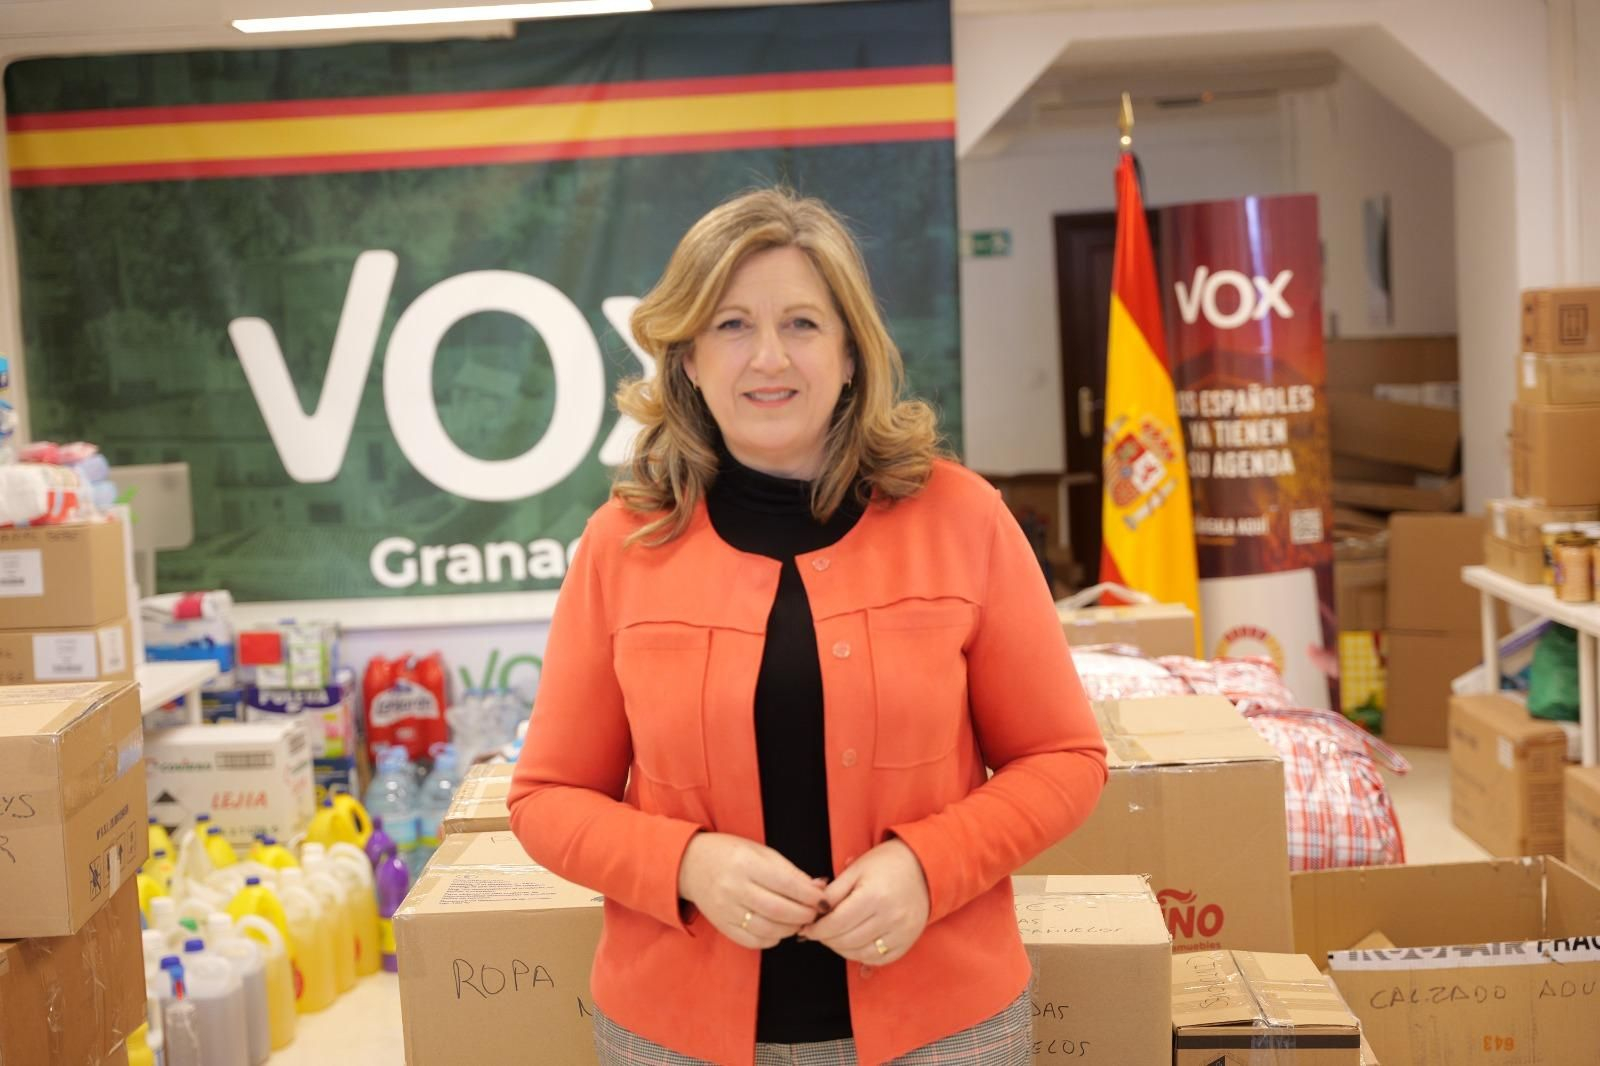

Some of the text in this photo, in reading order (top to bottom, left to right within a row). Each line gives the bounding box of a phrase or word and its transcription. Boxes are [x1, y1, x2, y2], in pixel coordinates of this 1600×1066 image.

[1175, 265, 1294, 329] VOX
[1200, 383, 1314, 418] ESPAÑOLES
[1188, 417, 1288, 448] YA TIENEN
[1212, 448, 1296, 478] AGENDA
[369, 536, 583, 588] Grana
[1157, 888, 1224, 938] ÑO
[452, 958, 554, 999] ROPA
[1370, 985, 1506, 1009] CALZADO
